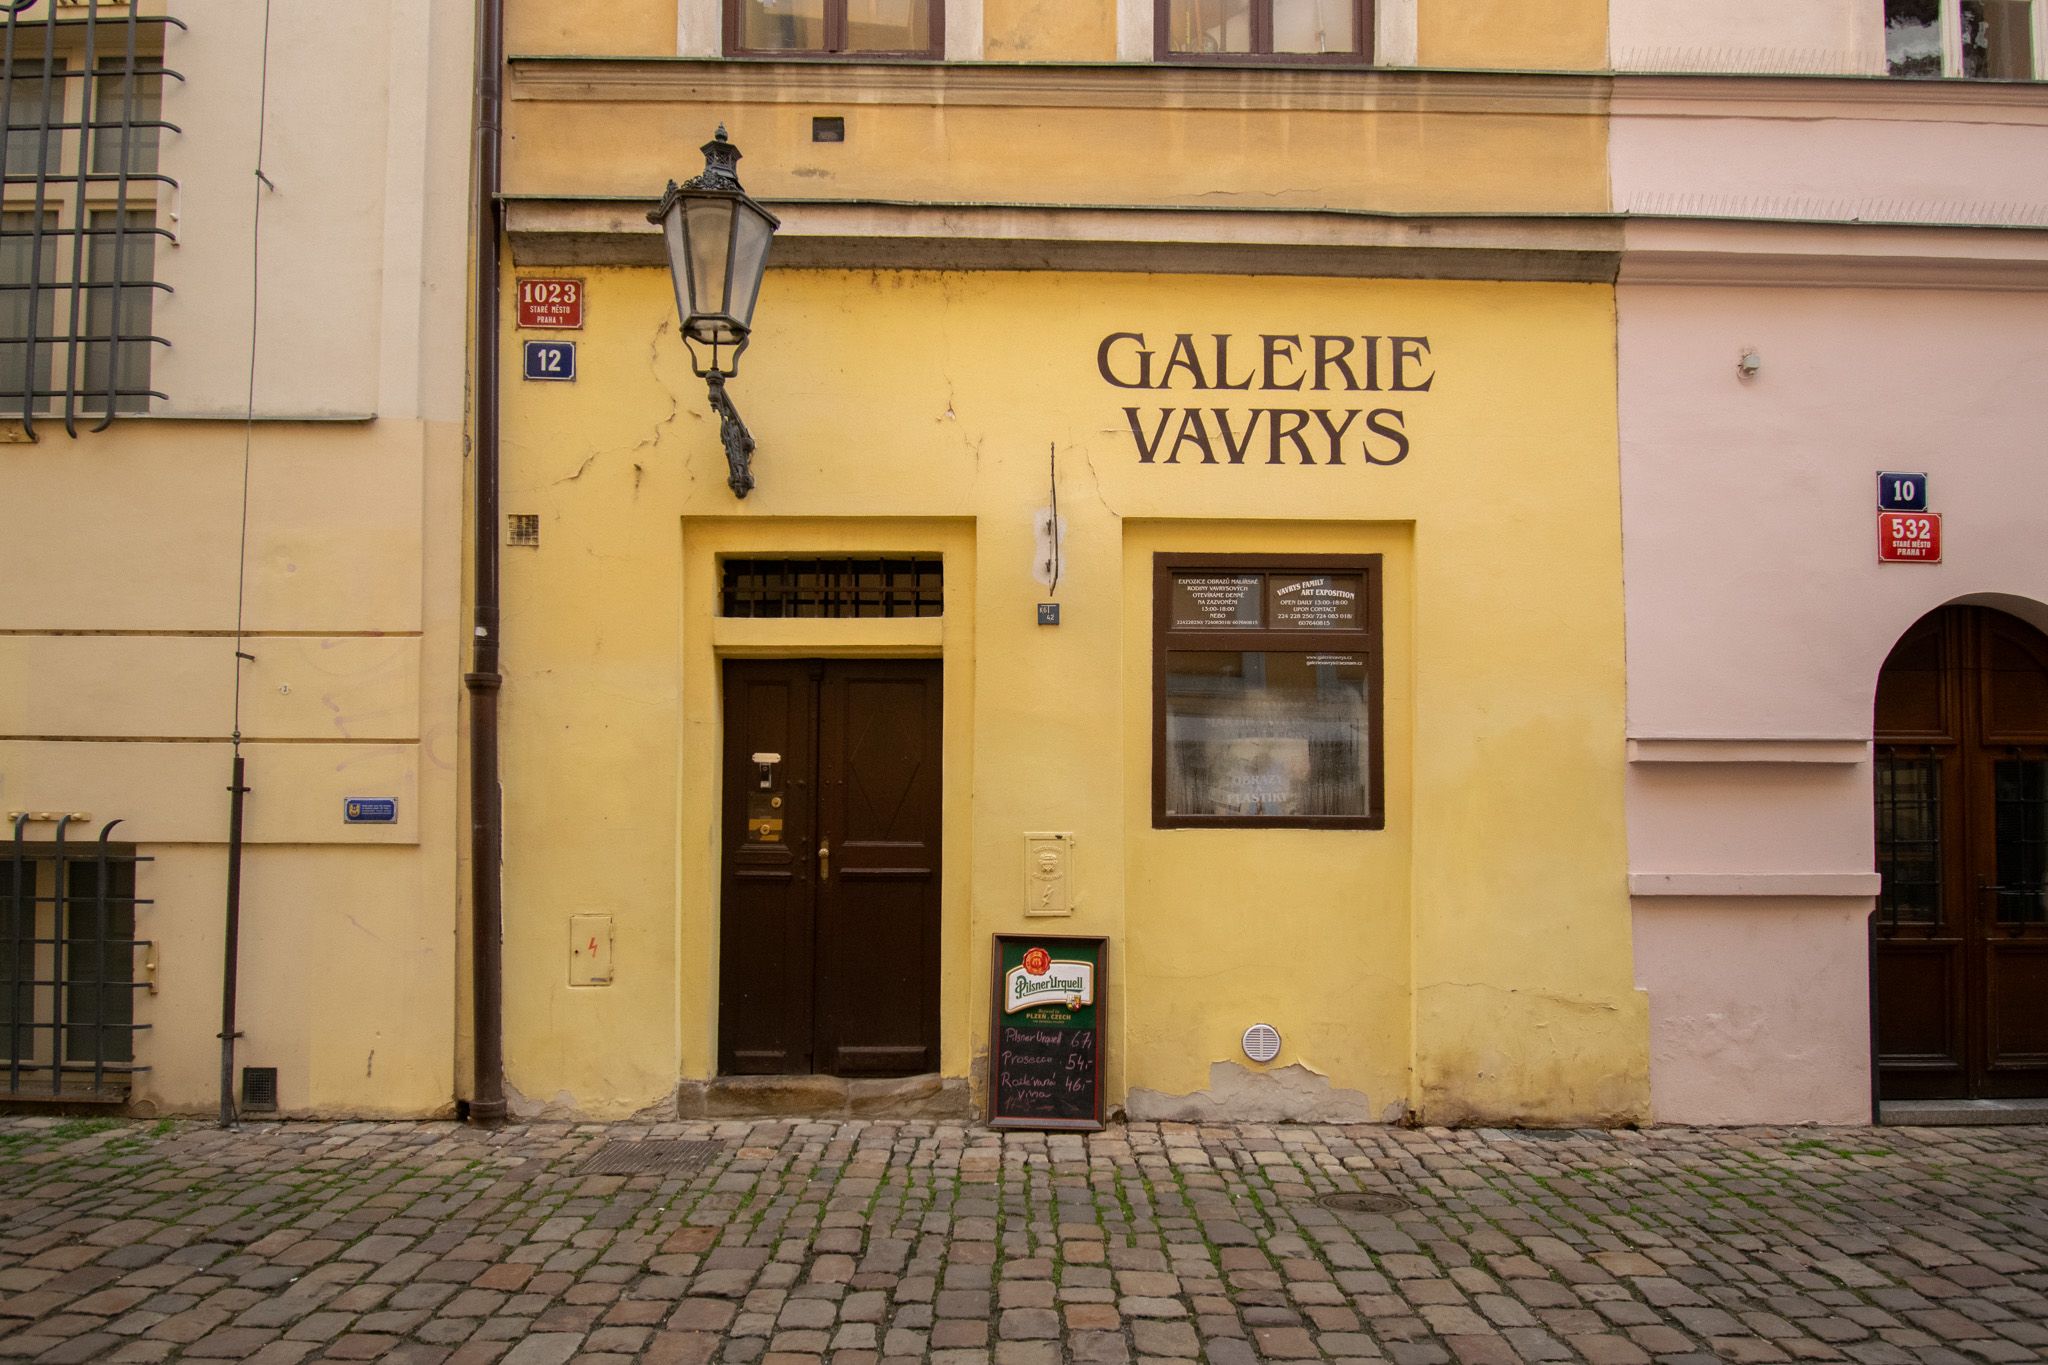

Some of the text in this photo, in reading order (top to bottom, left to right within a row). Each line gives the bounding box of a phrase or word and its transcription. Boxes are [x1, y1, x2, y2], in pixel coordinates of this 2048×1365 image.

[524, 283, 576, 303] 1023
[530, 305, 570, 313] STARÉ MĚSTO
[538, 349, 561, 371] 12
[1097, 332, 1435, 392] GALERIE
[1122, 407, 1409, 465] VAVRYS
[1894, 480, 1915, 501] 10
[1892, 519, 1930, 539] 532
[1893, 540, 1931, 548] STARÉ MĚSTO
[1897, 548, 1920, 556] PRAHA
[1277, 579, 1324, 596] VAVRYS FAMILY
[1316, 589, 1355, 600] EXPOSITION
[1227, 793, 1287, 803] PLASTIKY
[1015, 975, 1083, 999] Pilsner Urquell
[1002, 1051, 1052, 1064] Prosecco
